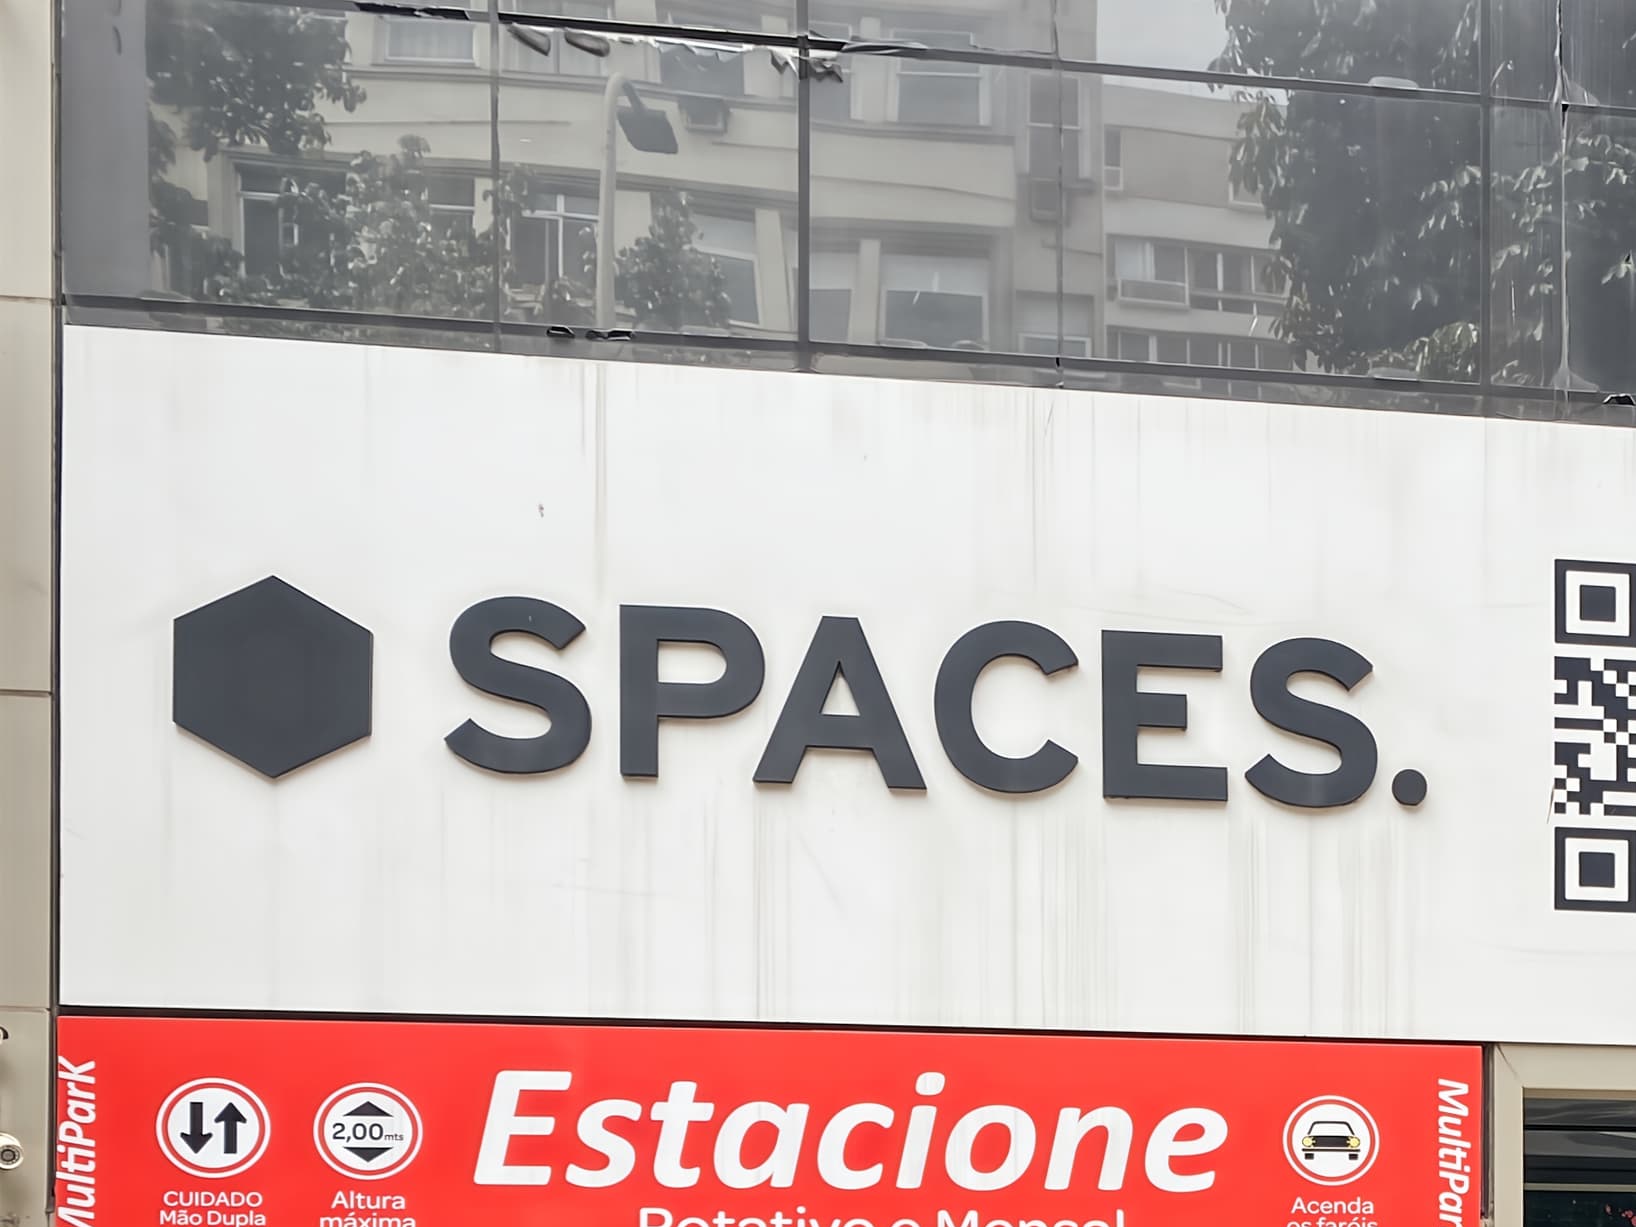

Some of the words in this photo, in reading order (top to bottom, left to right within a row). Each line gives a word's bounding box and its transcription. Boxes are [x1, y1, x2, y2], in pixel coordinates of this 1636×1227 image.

[444, 596, 1428, 809] SPACES.
[473, 1069, 1229, 1193] Estacione
[163, 1191, 263, 1207] CUIDADO
[331, 1190, 406, 1210] Altura
[1291, 1196, 1374, 1214] Acenda
[159, 1210, 202, 1226] Mão
